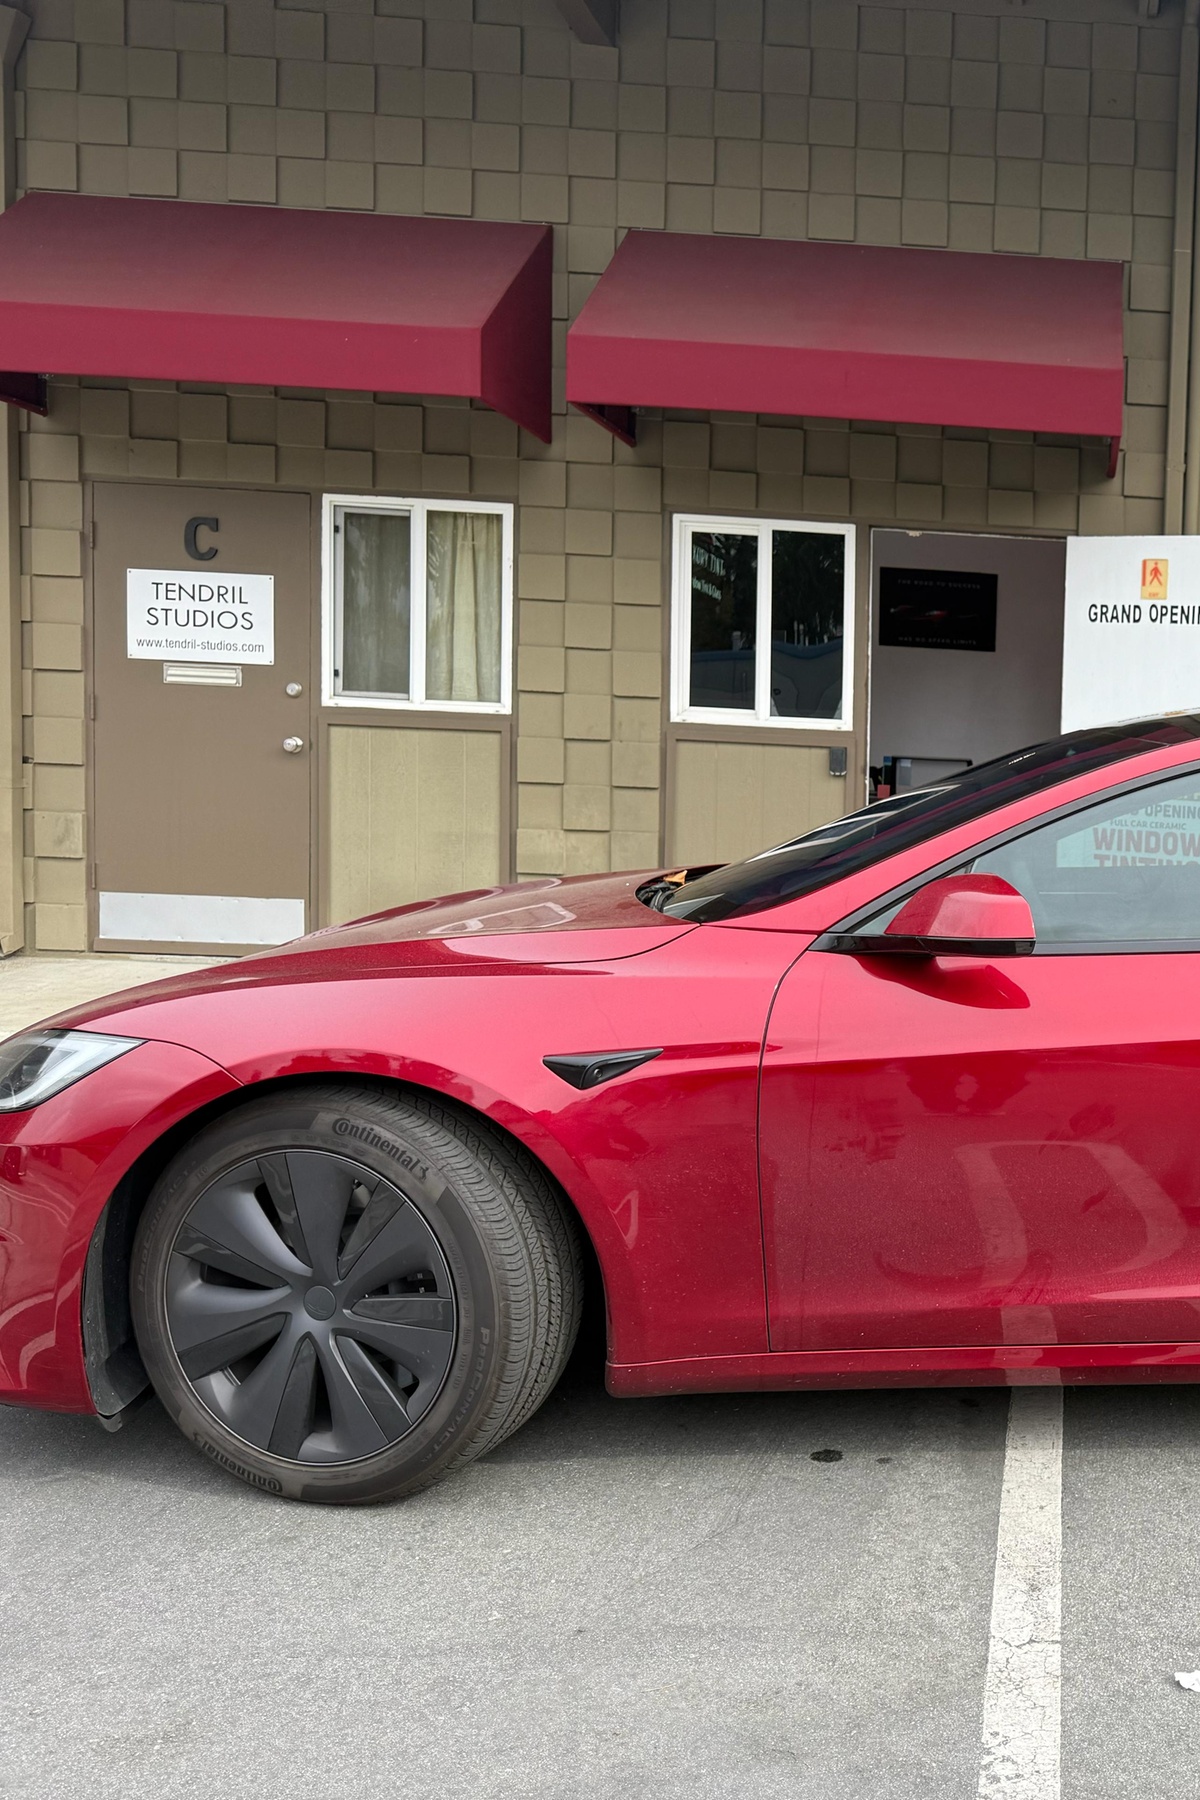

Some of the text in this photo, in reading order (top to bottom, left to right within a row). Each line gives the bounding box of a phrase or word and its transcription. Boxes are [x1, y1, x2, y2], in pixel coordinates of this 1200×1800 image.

[184, 516, 219, 561] C
[151, 582, 249, 604] TENDRIL
[146, 607, 254, 630] STUDIOS
[1088, 603, 1142, 624] GRAND
[136, 638, 265, 653] www.tendril-studios.com
[1130, 820, 1149, 828] CAR
[1149, 821, 1187, 831] CERAMIC
[331, 1117, 421, 1173] Continental
